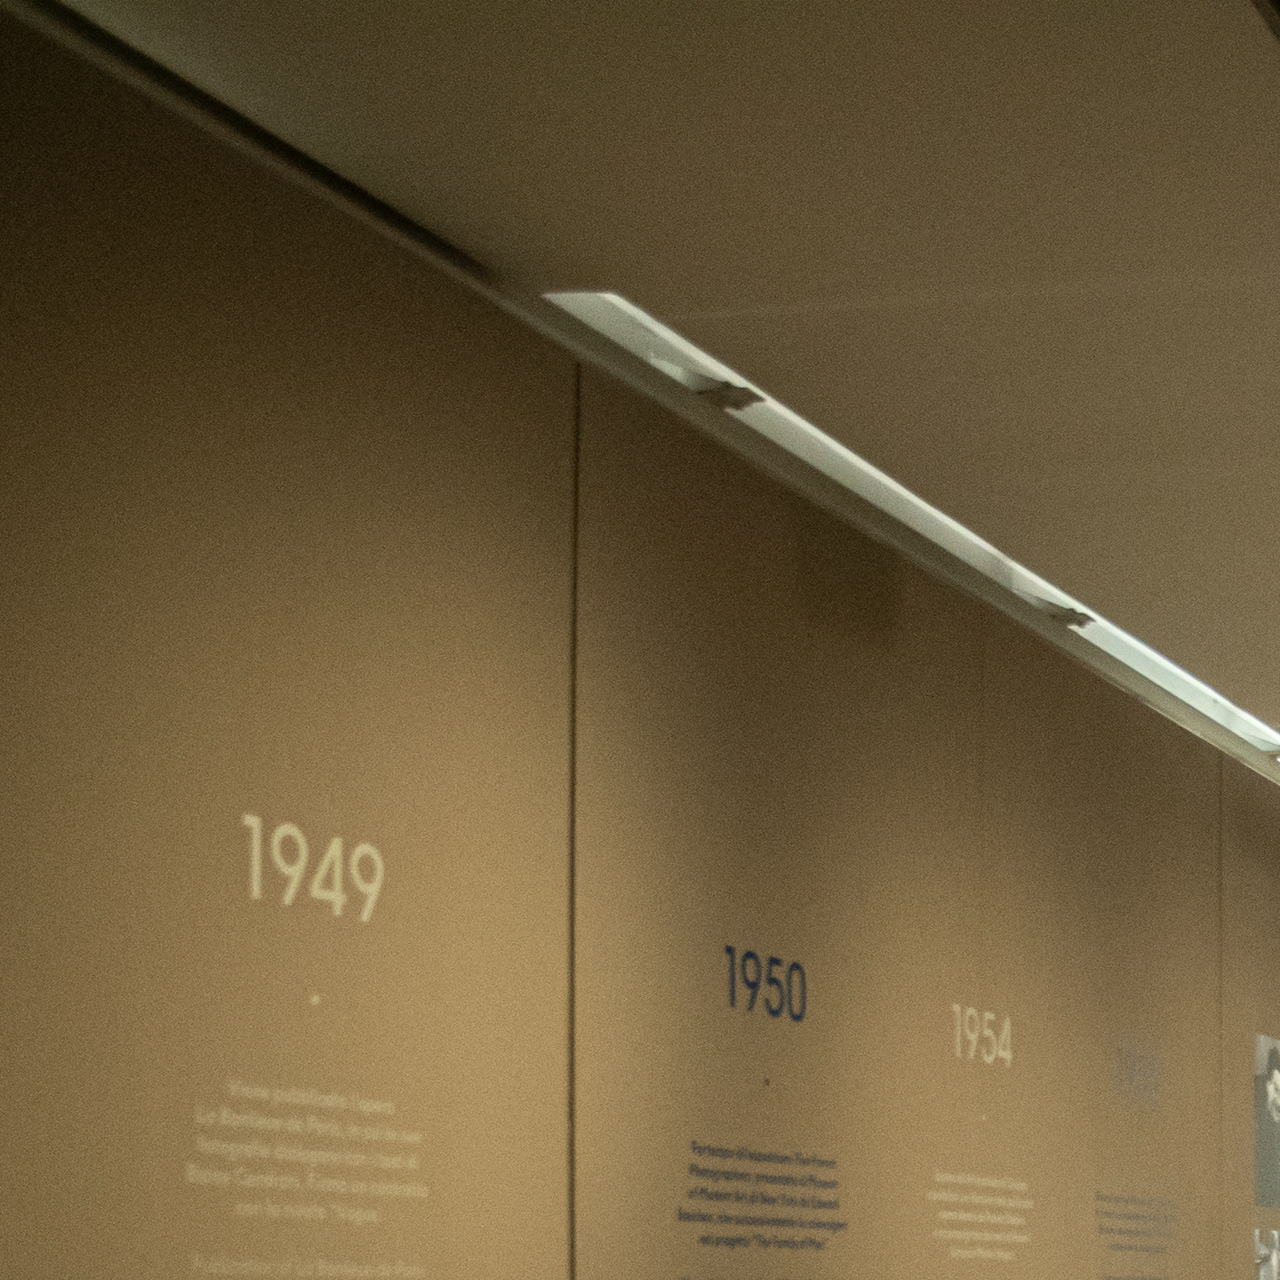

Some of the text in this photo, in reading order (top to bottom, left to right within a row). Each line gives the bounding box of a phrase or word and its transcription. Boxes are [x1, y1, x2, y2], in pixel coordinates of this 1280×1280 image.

[242, 813, 387, 922] 1949
[723, 945, 808, 1023] 1950
[951, 1002, 1014, 1068] 1954
